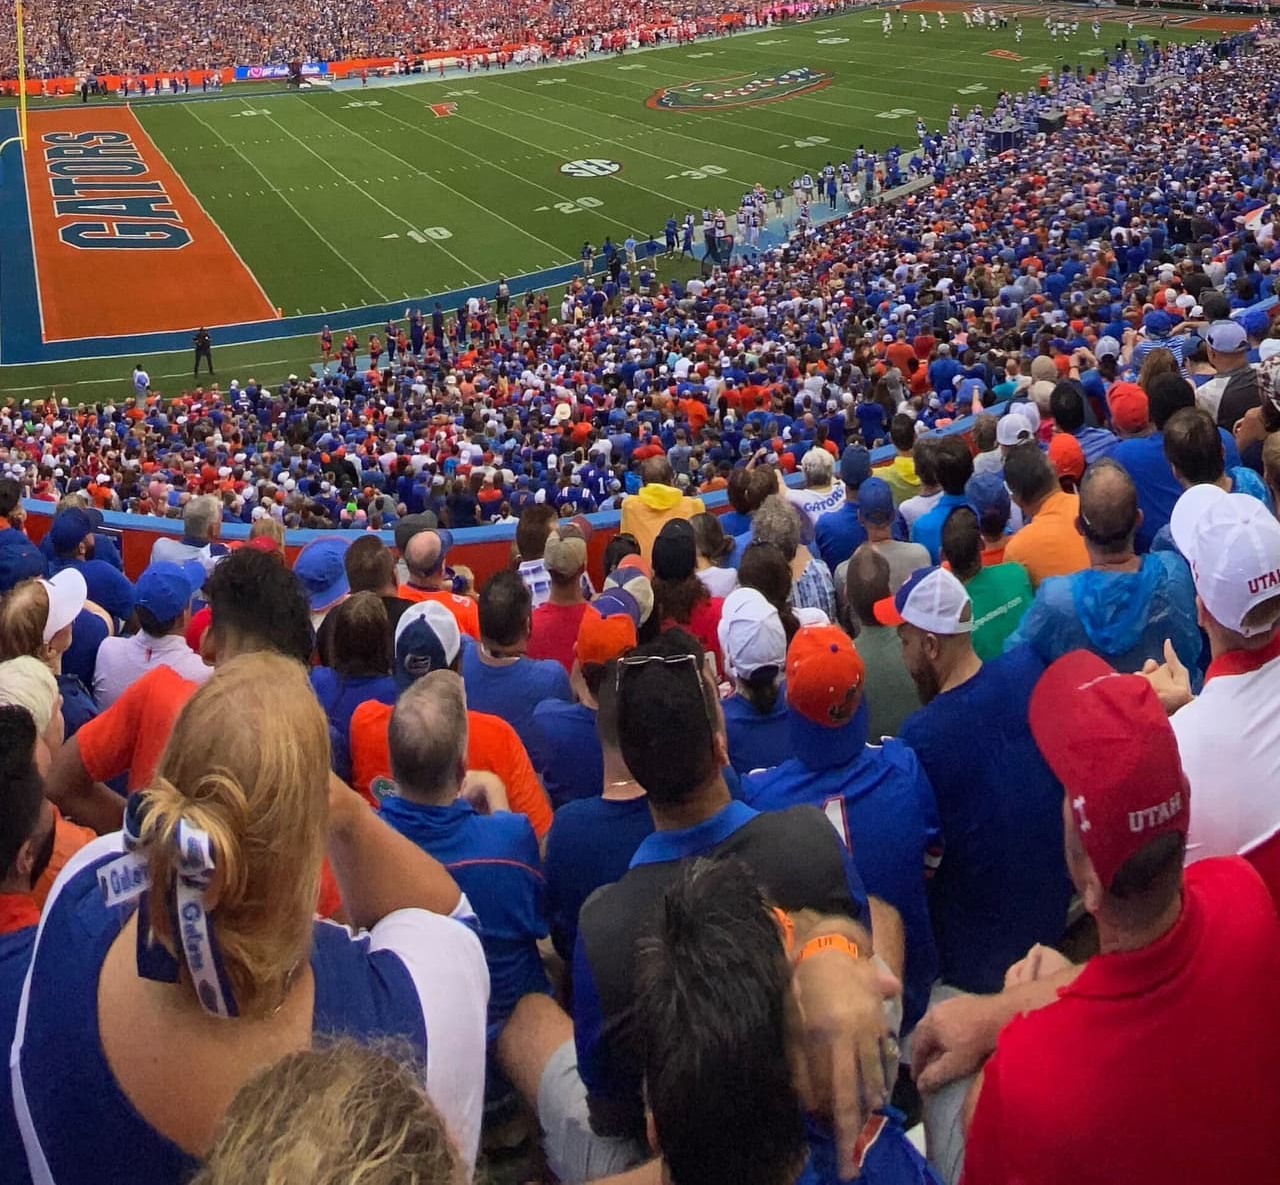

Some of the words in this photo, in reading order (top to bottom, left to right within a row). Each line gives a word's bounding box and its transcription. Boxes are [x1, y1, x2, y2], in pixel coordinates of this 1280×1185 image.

[794, 135, 831, 149] 40
[561, 160, 621, 177] SEC
[681, 165, 728, 180] 30
[40, 128, 194, 251] GATORS
[554, 196, 605, 214] 20
[407, 226, 454, 243] 10
[803, 485, 846, 512] GATORS
[1128, 792, 1183, 833] UTAH
